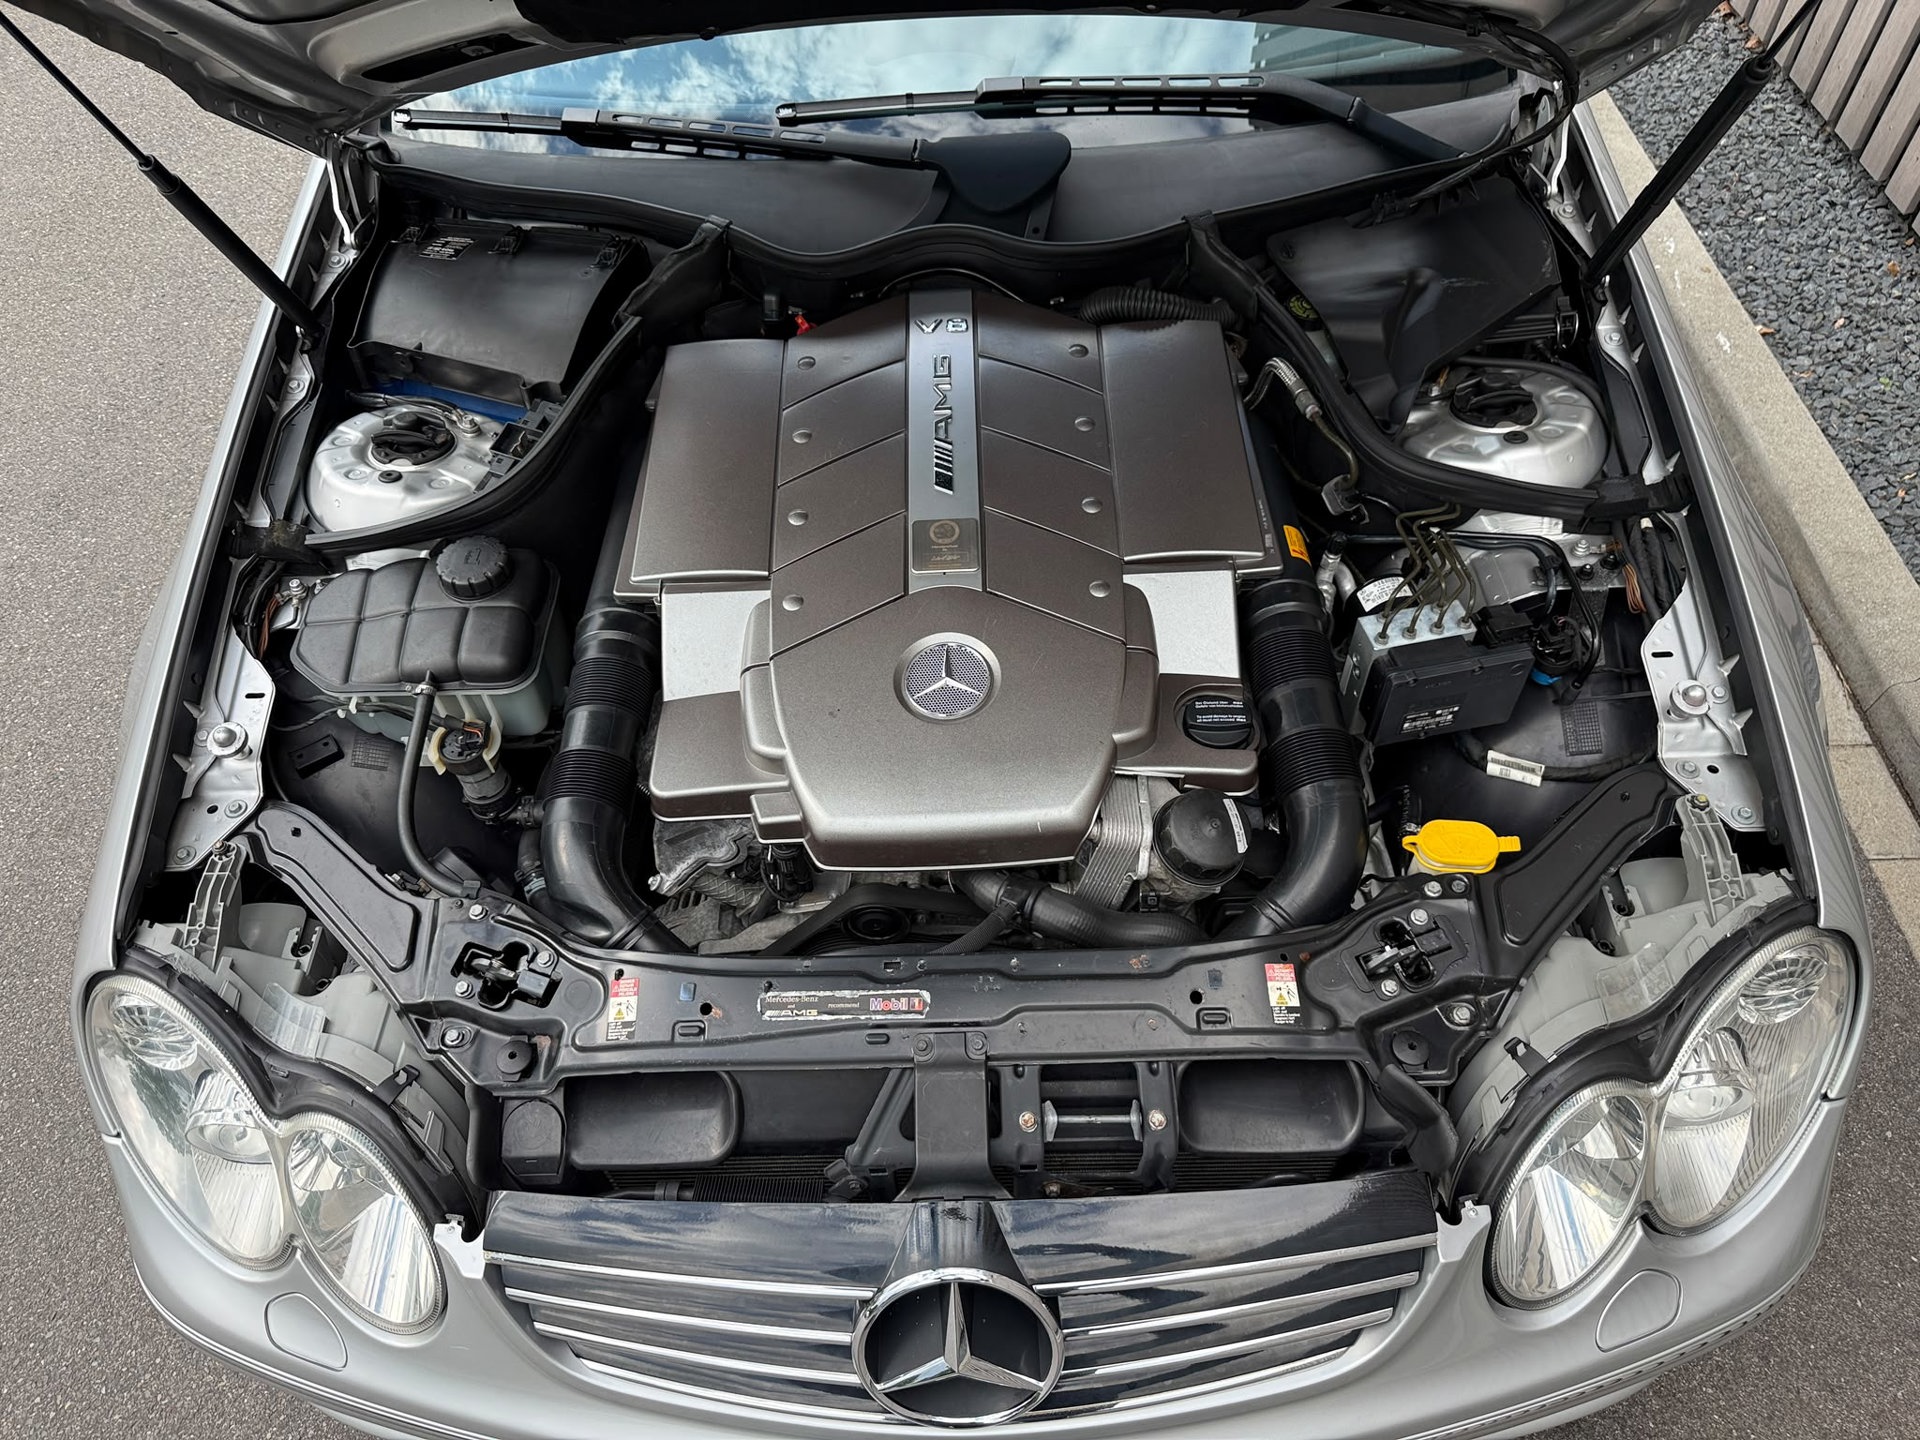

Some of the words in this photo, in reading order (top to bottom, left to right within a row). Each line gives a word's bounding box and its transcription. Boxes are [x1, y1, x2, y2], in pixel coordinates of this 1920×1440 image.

[933, 354, 952, 447] AMG
[765, 995, 819, 1003] Mercedes-Benz
[870, 997, 909, 1011] Mobil
[780, 1009, 819, 1017] AMG
